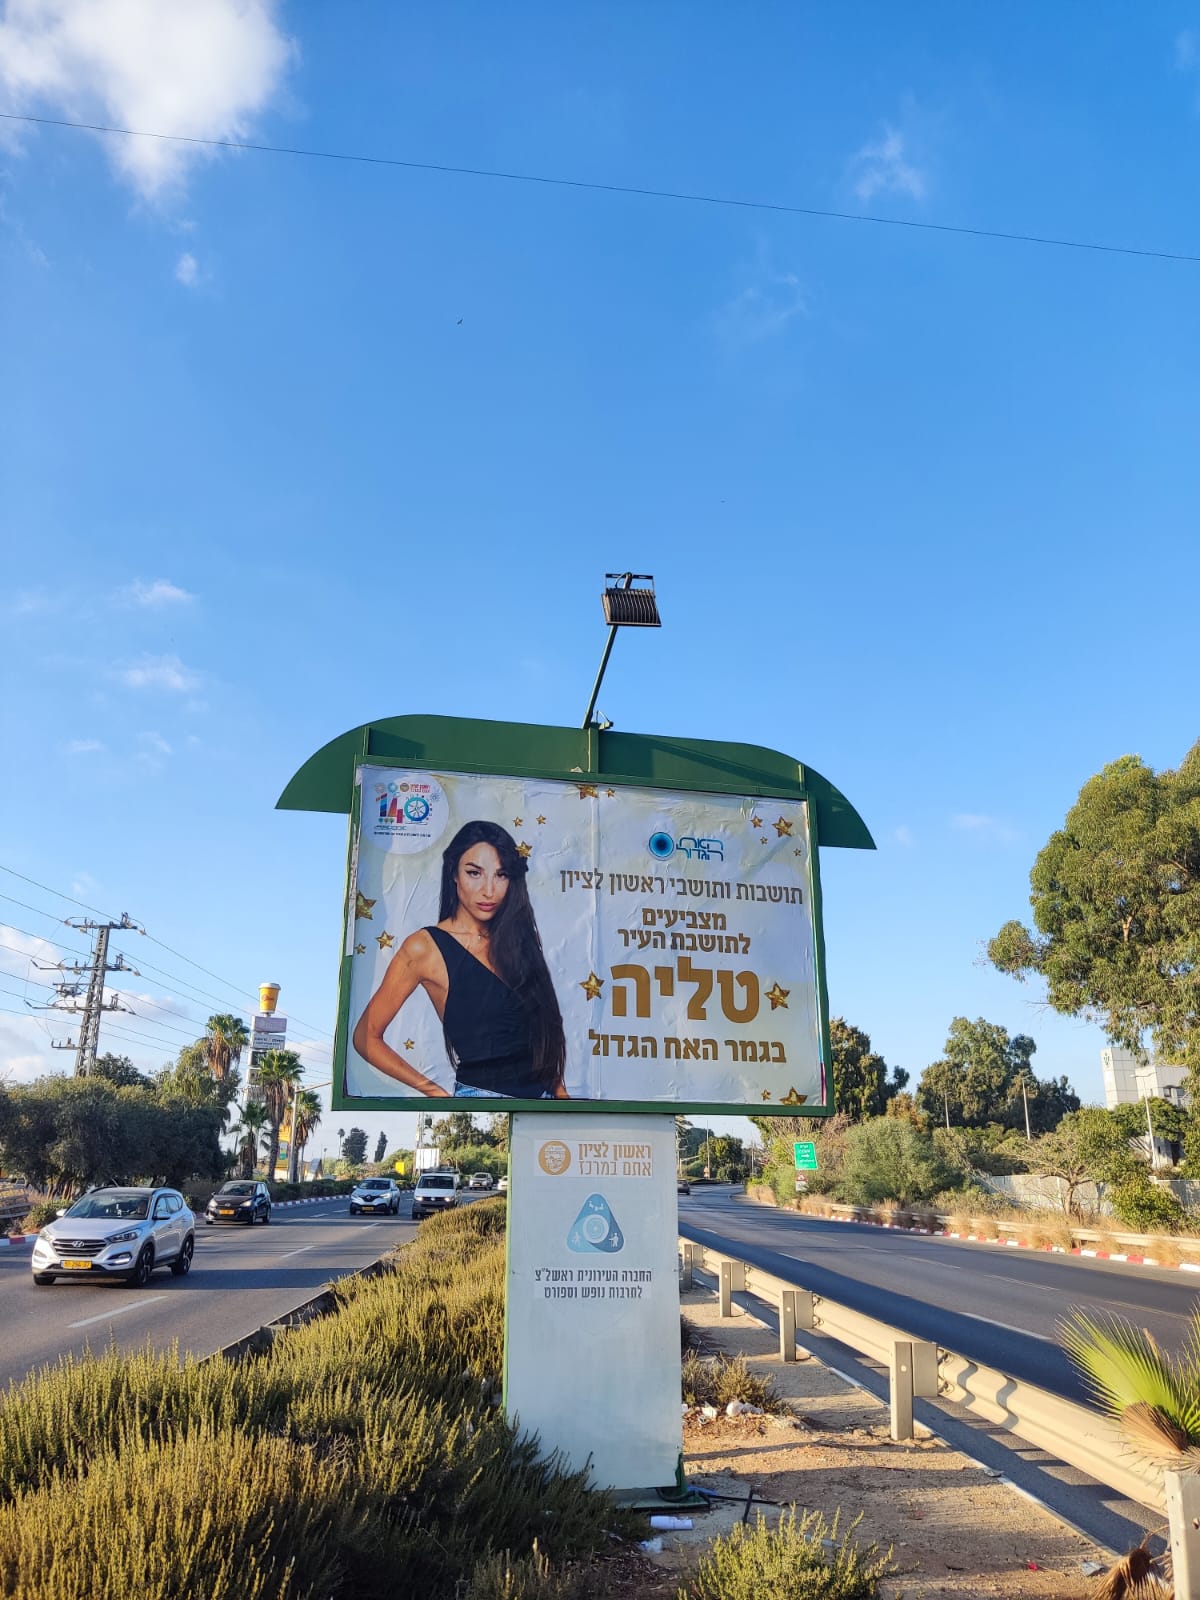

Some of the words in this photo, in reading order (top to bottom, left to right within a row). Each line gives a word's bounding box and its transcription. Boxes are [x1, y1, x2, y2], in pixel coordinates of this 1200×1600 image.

[560, 868, 604, 893] לציון
[609, 872, 665, 896] ראשון
[669, 877, 731, 900] ותושבי
[735, 882, 803, 905] תושבות
[641, 907, 727, 931] מצביעים
[617, 928, 666, 950] העיר
[670, 931, 751, 955] לתושבת
[610, 956, 760, 1024] טליה
[588, 1029, 658, 1059] הגדול
[663, 1036, 718, 1060] האח
[724, 1038, 787, 1063] בגמר
[578, 1142, 609, 1161] לציון
[612, 1144, 652, 1161] ראשון
[578, 1160, 618, 1176] במרכז
[622, 1161, 652, 1177] אתם
[577, 1269, 619, 1283] העירונית
[621, 1270, 652, 1282] החברה
[544, 1286, 578, 1299] וספורט
[581, 1286, 605, 1299] נופש
[608, 1285, 643, 1299] לתרבות
